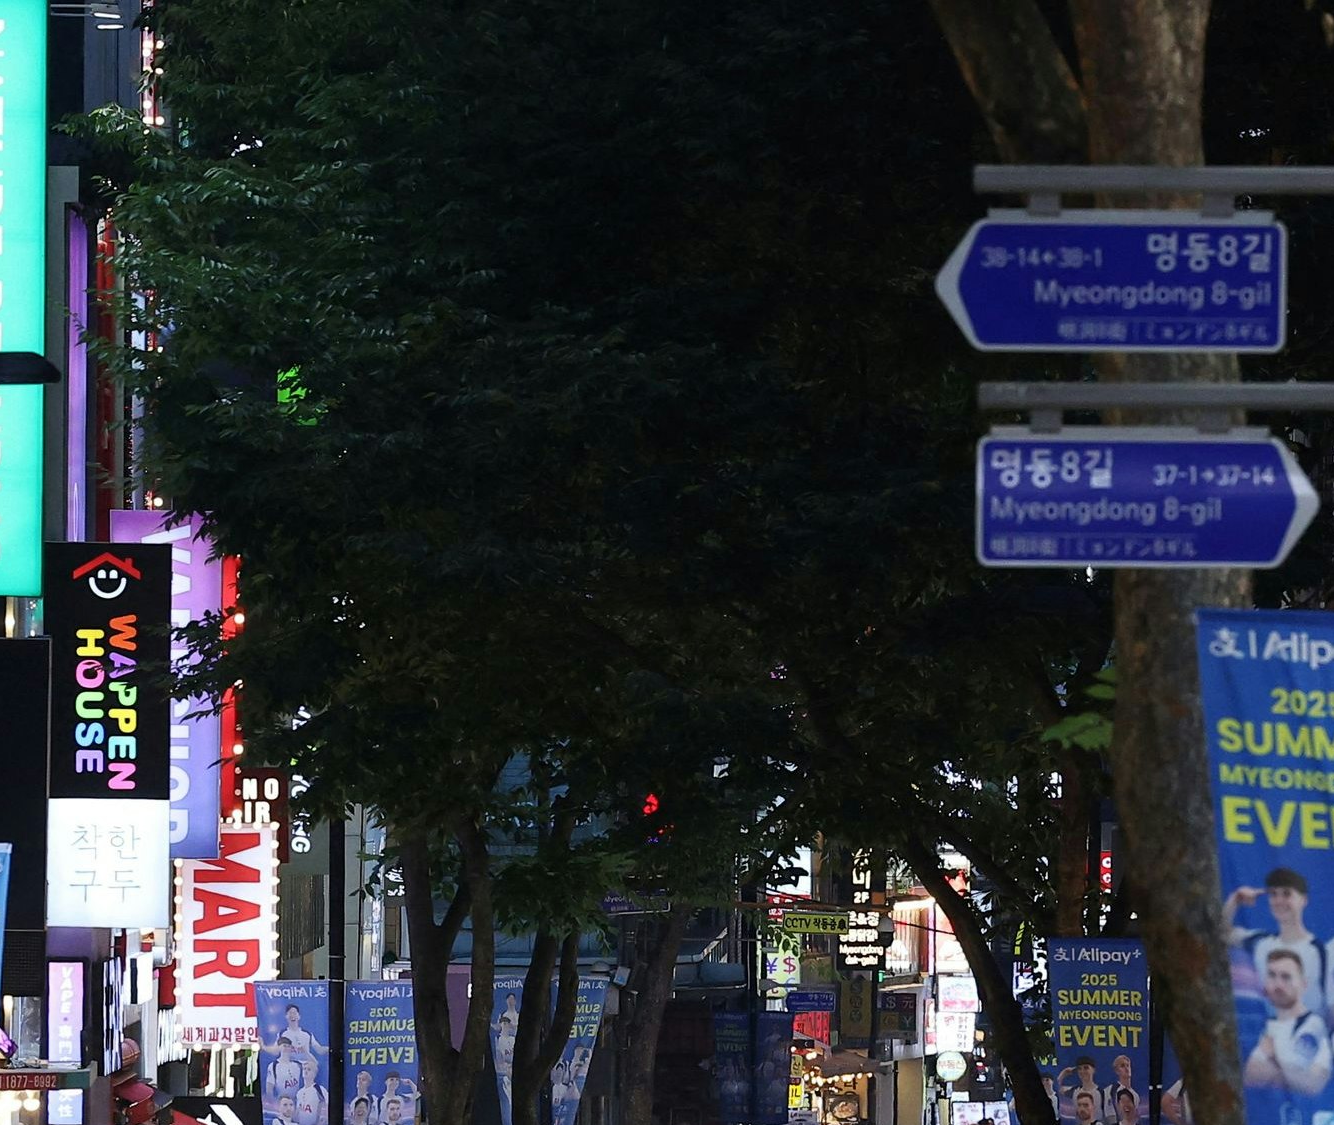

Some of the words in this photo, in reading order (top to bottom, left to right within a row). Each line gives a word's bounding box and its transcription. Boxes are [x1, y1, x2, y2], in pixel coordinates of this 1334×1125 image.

[1146, 231, 1272, 273] 명동8길
[1034, 279, 1204, 311] Myeongdong
[1211, 279, 1272, 311] 8-gil
[989, 449, 1113, 490] 명동8길
[990, 495, 1157, 527] Myeongdong
[1163, 496, 1223, 527] 8-gil
[75, 629, 105, 773] HOUSE
[108, 614, 137, 790] WAPPEN
[242, 777, 279, 800] NO
[71, 824, 141, 860] 착한
[69, 870, 142, 904] 구두
[193, 833, 261, 1017] MART
[785, 916, 811, 929] CCTV
[1081, 973, 1117, 987] 2025
[1058, 989, 1142, 1007] SUMMER
[1058, 1010, 1142, 1021] MYEONGDONG
[1059, 1025, 1142, 1048] EVENT
